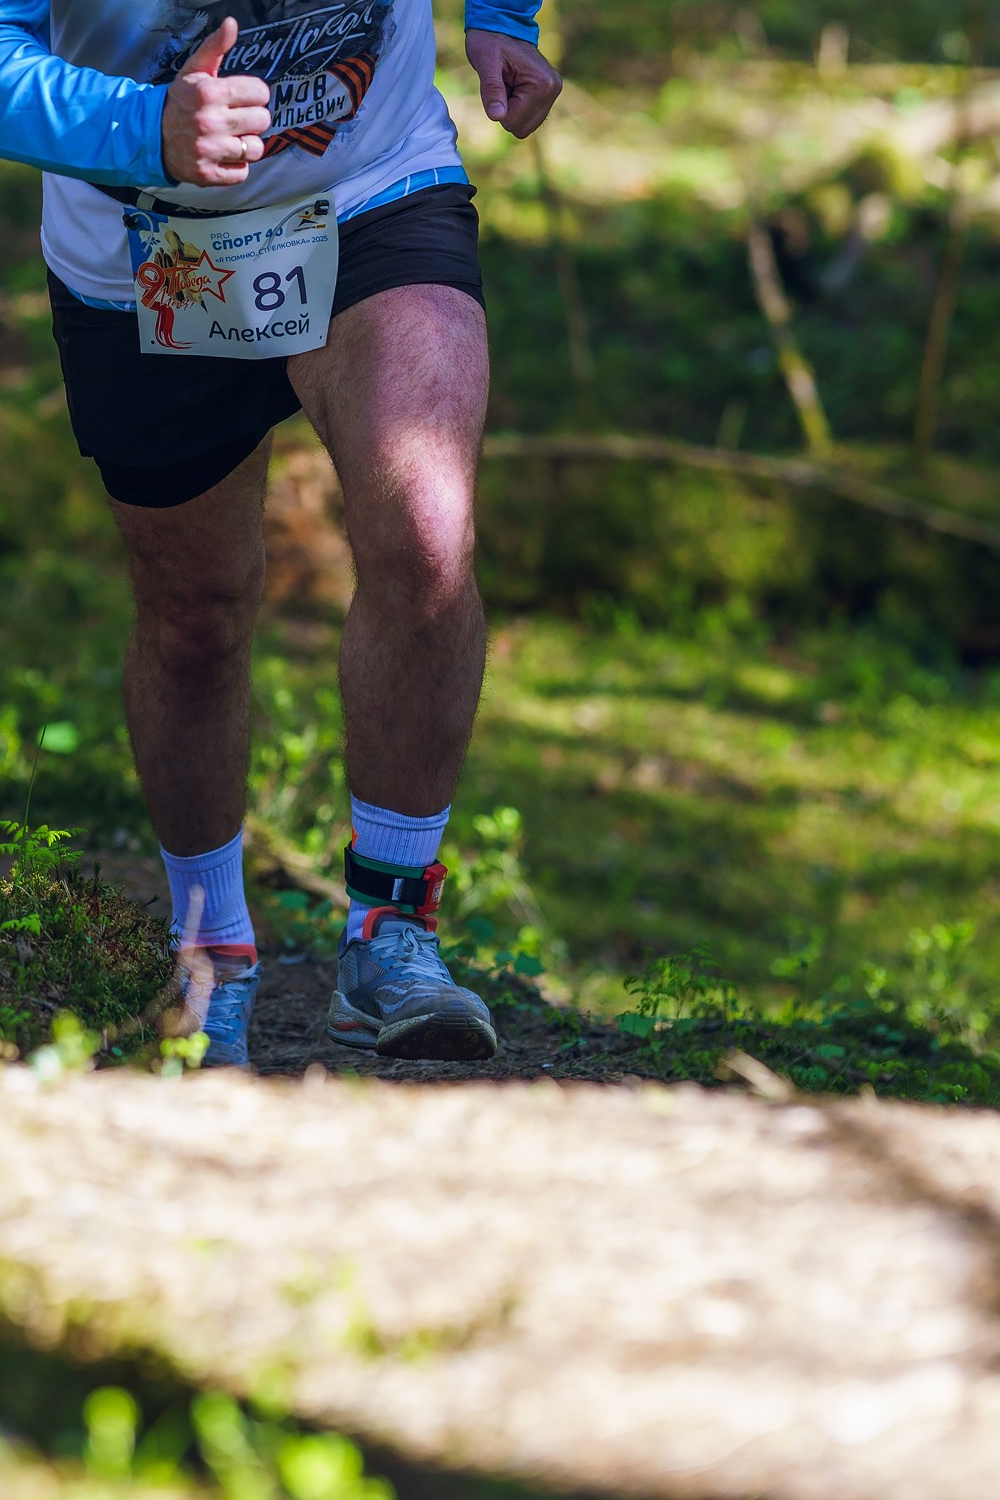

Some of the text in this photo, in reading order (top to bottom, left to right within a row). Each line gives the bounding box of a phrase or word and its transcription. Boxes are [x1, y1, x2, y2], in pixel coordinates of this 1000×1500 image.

[271, 94, 346, 128] ИЛЬЕВИЧ
[210, 231, 230, 240] PRO
[212, 231, 262, 251] СПОРТ
[311, 234, 329, 244] 2025
[252, 265, 309, 312] 81
[208, 312, 310, 343] Алексей
